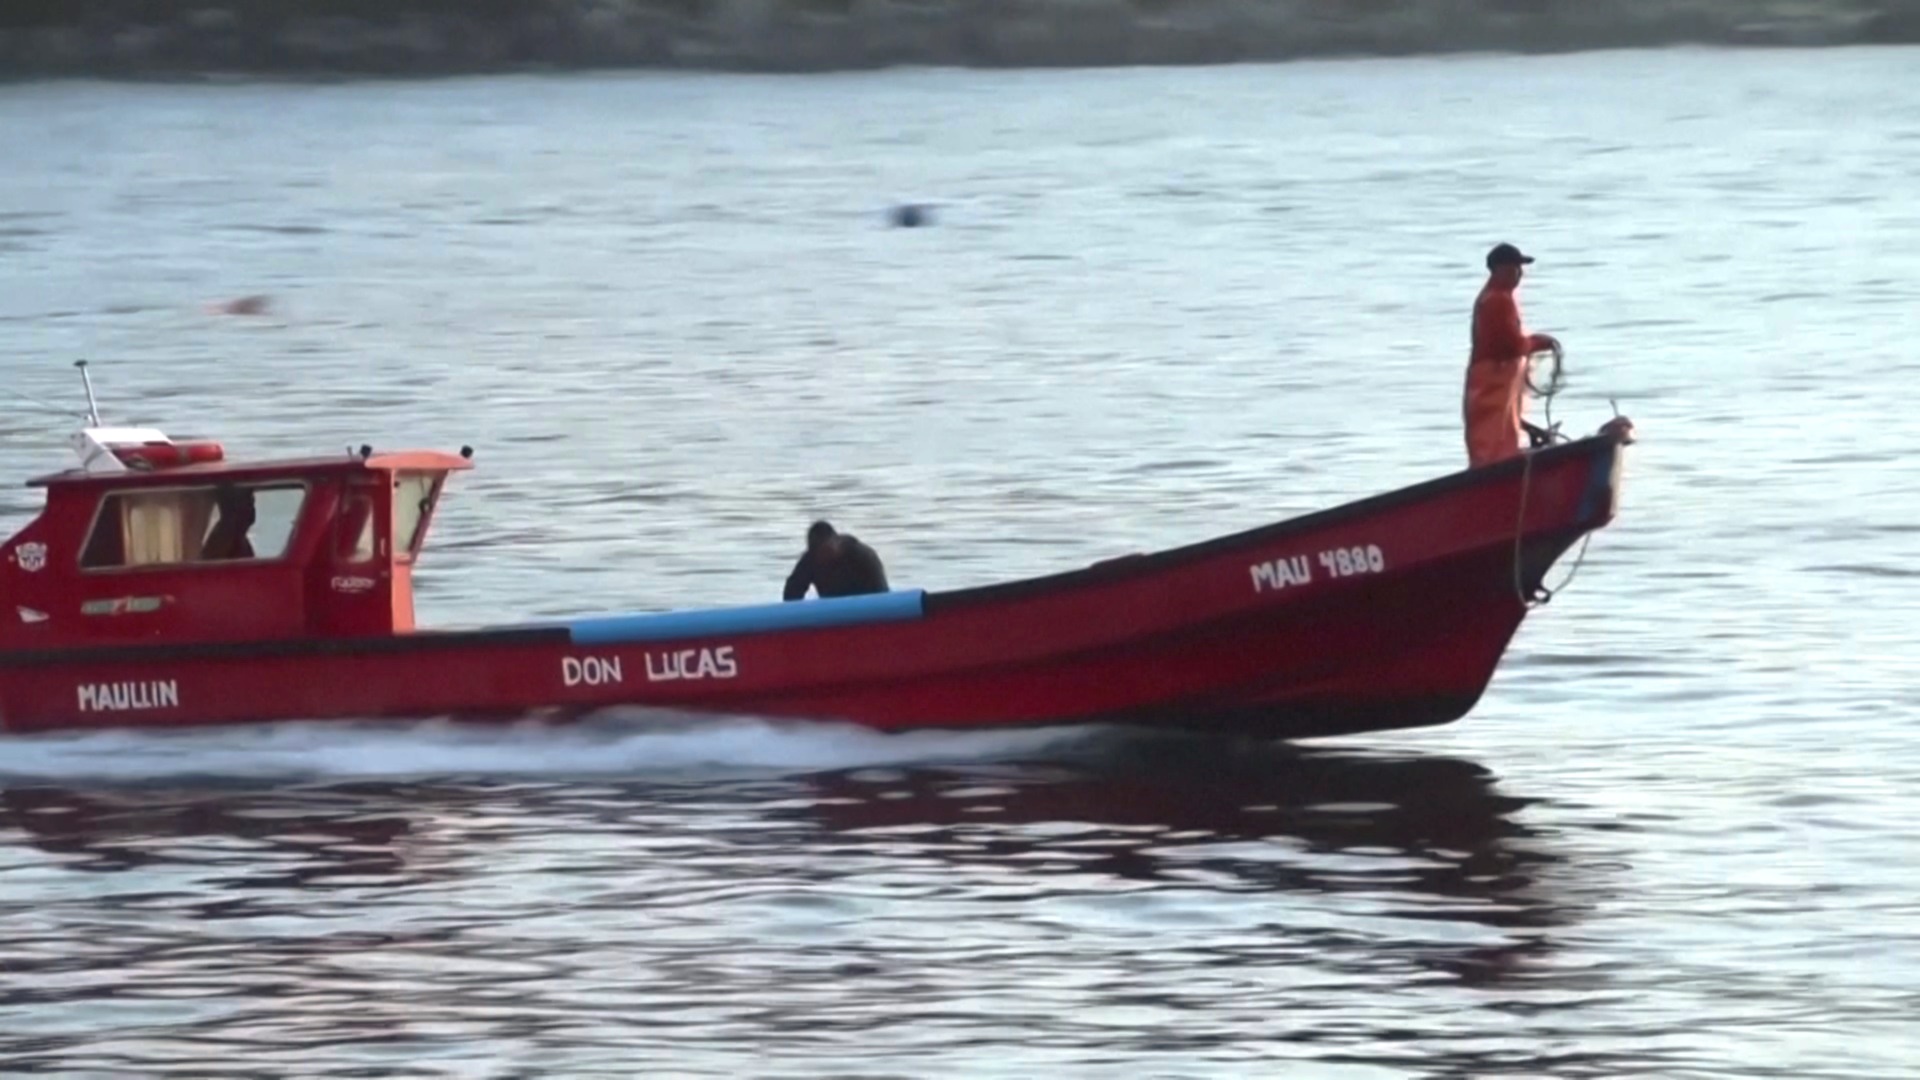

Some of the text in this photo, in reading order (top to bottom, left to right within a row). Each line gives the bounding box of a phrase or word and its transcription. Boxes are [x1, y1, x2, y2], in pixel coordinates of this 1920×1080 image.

[1250, 544, 1384, 593] MAU 4880
[562, 646, 737, 686] DON LUCAS
[77, 679, 178, 711] MAULLIN
